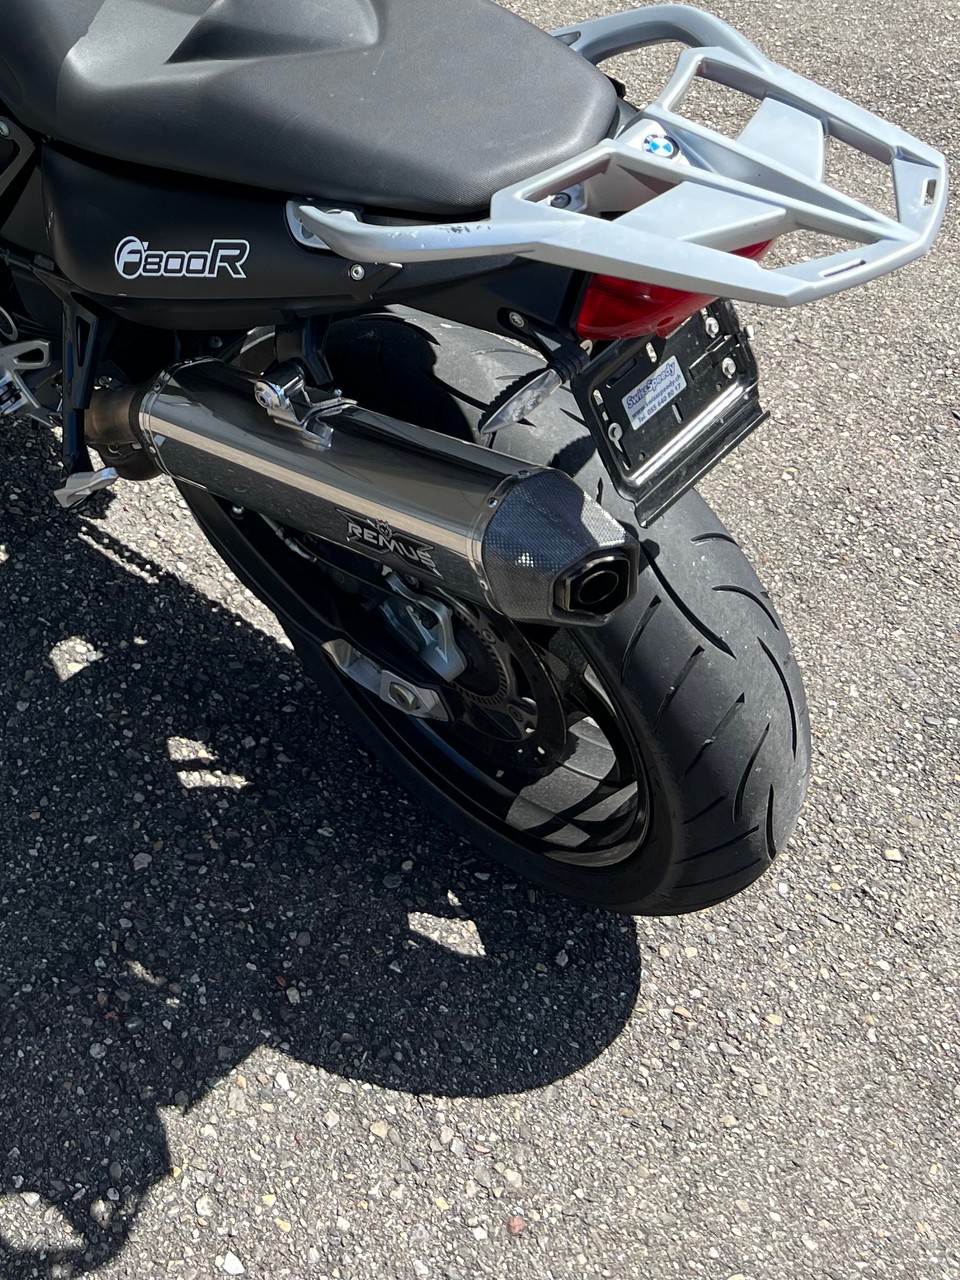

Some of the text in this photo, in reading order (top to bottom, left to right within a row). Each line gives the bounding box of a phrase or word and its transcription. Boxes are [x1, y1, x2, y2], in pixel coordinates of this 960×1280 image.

[114, 235, 250, 279] F800R
[626, 361, 676, 409] SwissSpeedy
[674, 383, 681, 391] 17
[346, 521, 437, 569] REMUS
